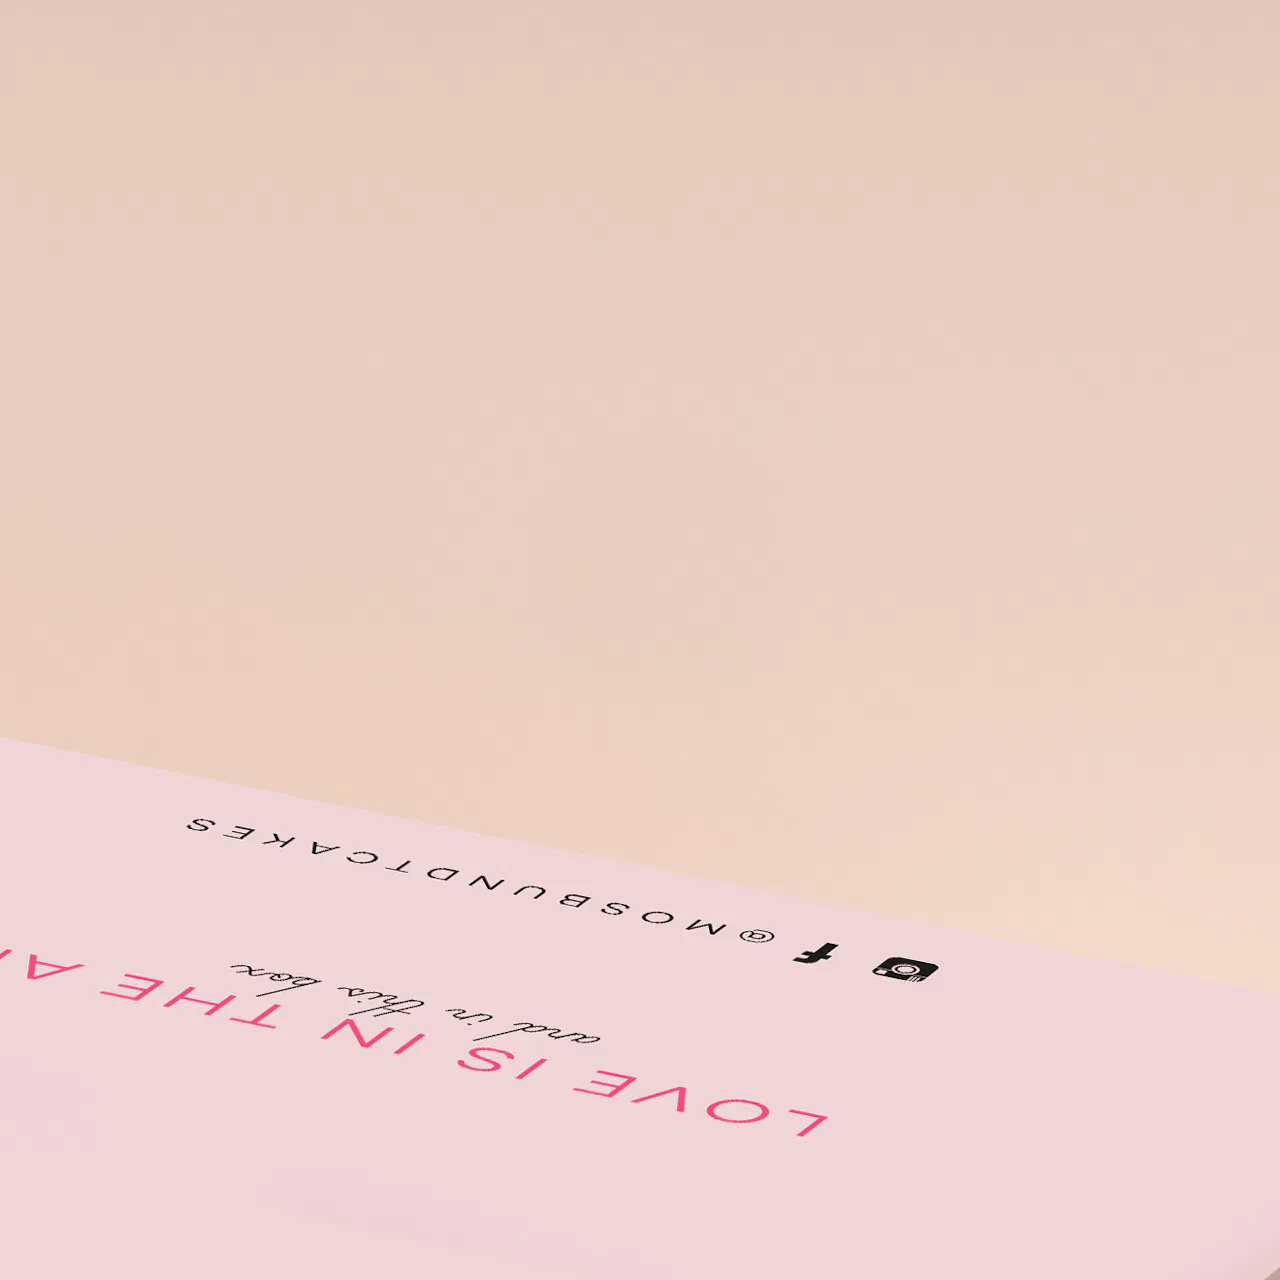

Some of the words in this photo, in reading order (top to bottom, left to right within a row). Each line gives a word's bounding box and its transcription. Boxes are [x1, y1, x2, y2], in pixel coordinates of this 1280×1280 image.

[186, 818, 776, 944] @MOSBUNDTCAKES
[229, 964, 323, 998] box
[99, 973, 281, 1029] THE
[336, 986, 425, 1018] this
[444, 1008, 495, 1024] in
[321, 1018, 426, 1055] IN
[472, 1022, 601, 1044] and
[457, 1046, 547, 1080] IS
[572, 1069, 829, 1137] LOVE
